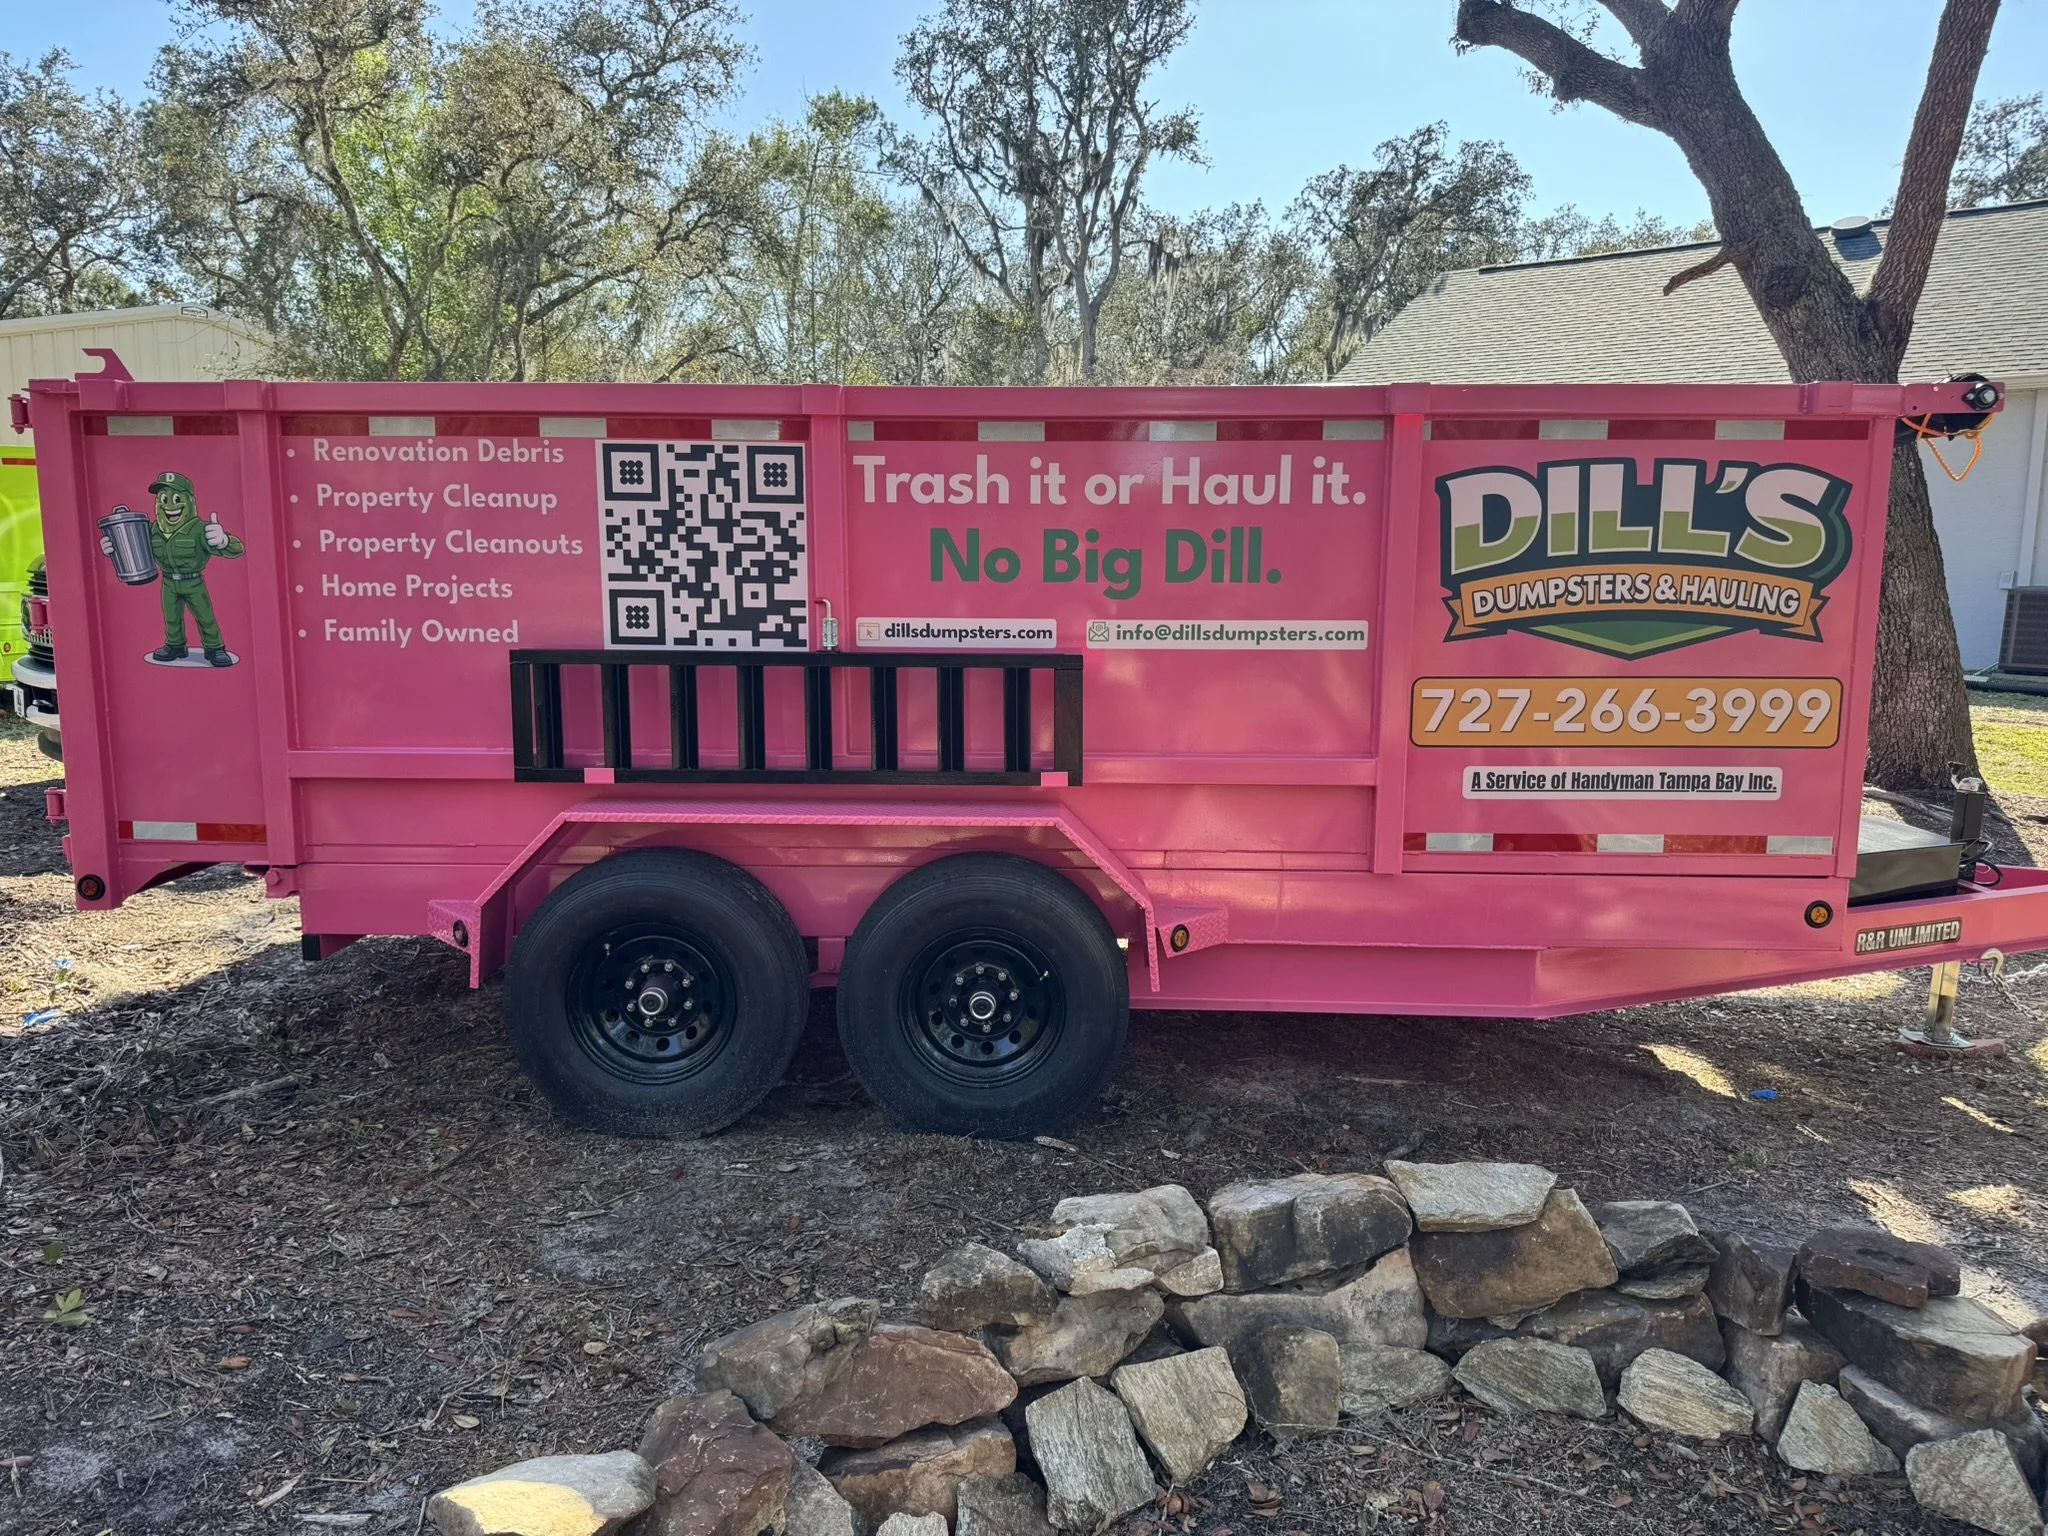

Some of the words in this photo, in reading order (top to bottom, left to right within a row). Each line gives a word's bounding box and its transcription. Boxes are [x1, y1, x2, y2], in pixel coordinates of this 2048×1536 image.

[313, 438, 469, 462] Renovation
[478, 439, 565, 463] Debris
[165, 473, 175, 482] D
[853, 455, 1010, 504] Trash
[1030, 457, 1066, 504] it
[1084, 473, 1144, 505] or
[1162, 455, 1292, 505] Haul
[1312, 456, 1367, 505] it.
[316, 484, 433, 513] Property
[443, 483, 558, 515] Cleanup
[1445, 463, 1832, 576] DILL'S
[319, 529, 436, 559] Property
[445, 529, 584, 555] Cleanouts
[930, 527, 1021, 583] No
[1043, 528, 1143, 600] Big
[1164, 527, 1282, 584] Dill.
[321, 574, 397, 597] Home
[406, 574, 513, 604] Projects
[1472, 573, 1652, 618] DUMPSTERS
[1654, 573, 1678, 601] &
[1679, 575, 1802, 617] HAULING
[324, 619, 412, 648] Family
[421, 620, 519, 643] Owned
[884, 623, 1053, 643] dillsdumpsters.com
[1116, 624, 1365, 645] info@dillsdumpsters.com
[1420, 687, 1832, 734] 727-266-3999
[1471, 771, 1481, 790] A
[1486, 771, 1546, 790] Service
[1550, 771, 1567, 790] of
[1571, 771, 1653, 793] Handyman
[1659, 772, 1710, 793] Tampa
[1715, 772, 1744, 793] Bay
[1748, 772, 1777, 792] Inc.
[1856, 929, 1885, 952] R&R
[1889, 920, 1961, 948] UNLIMITED
